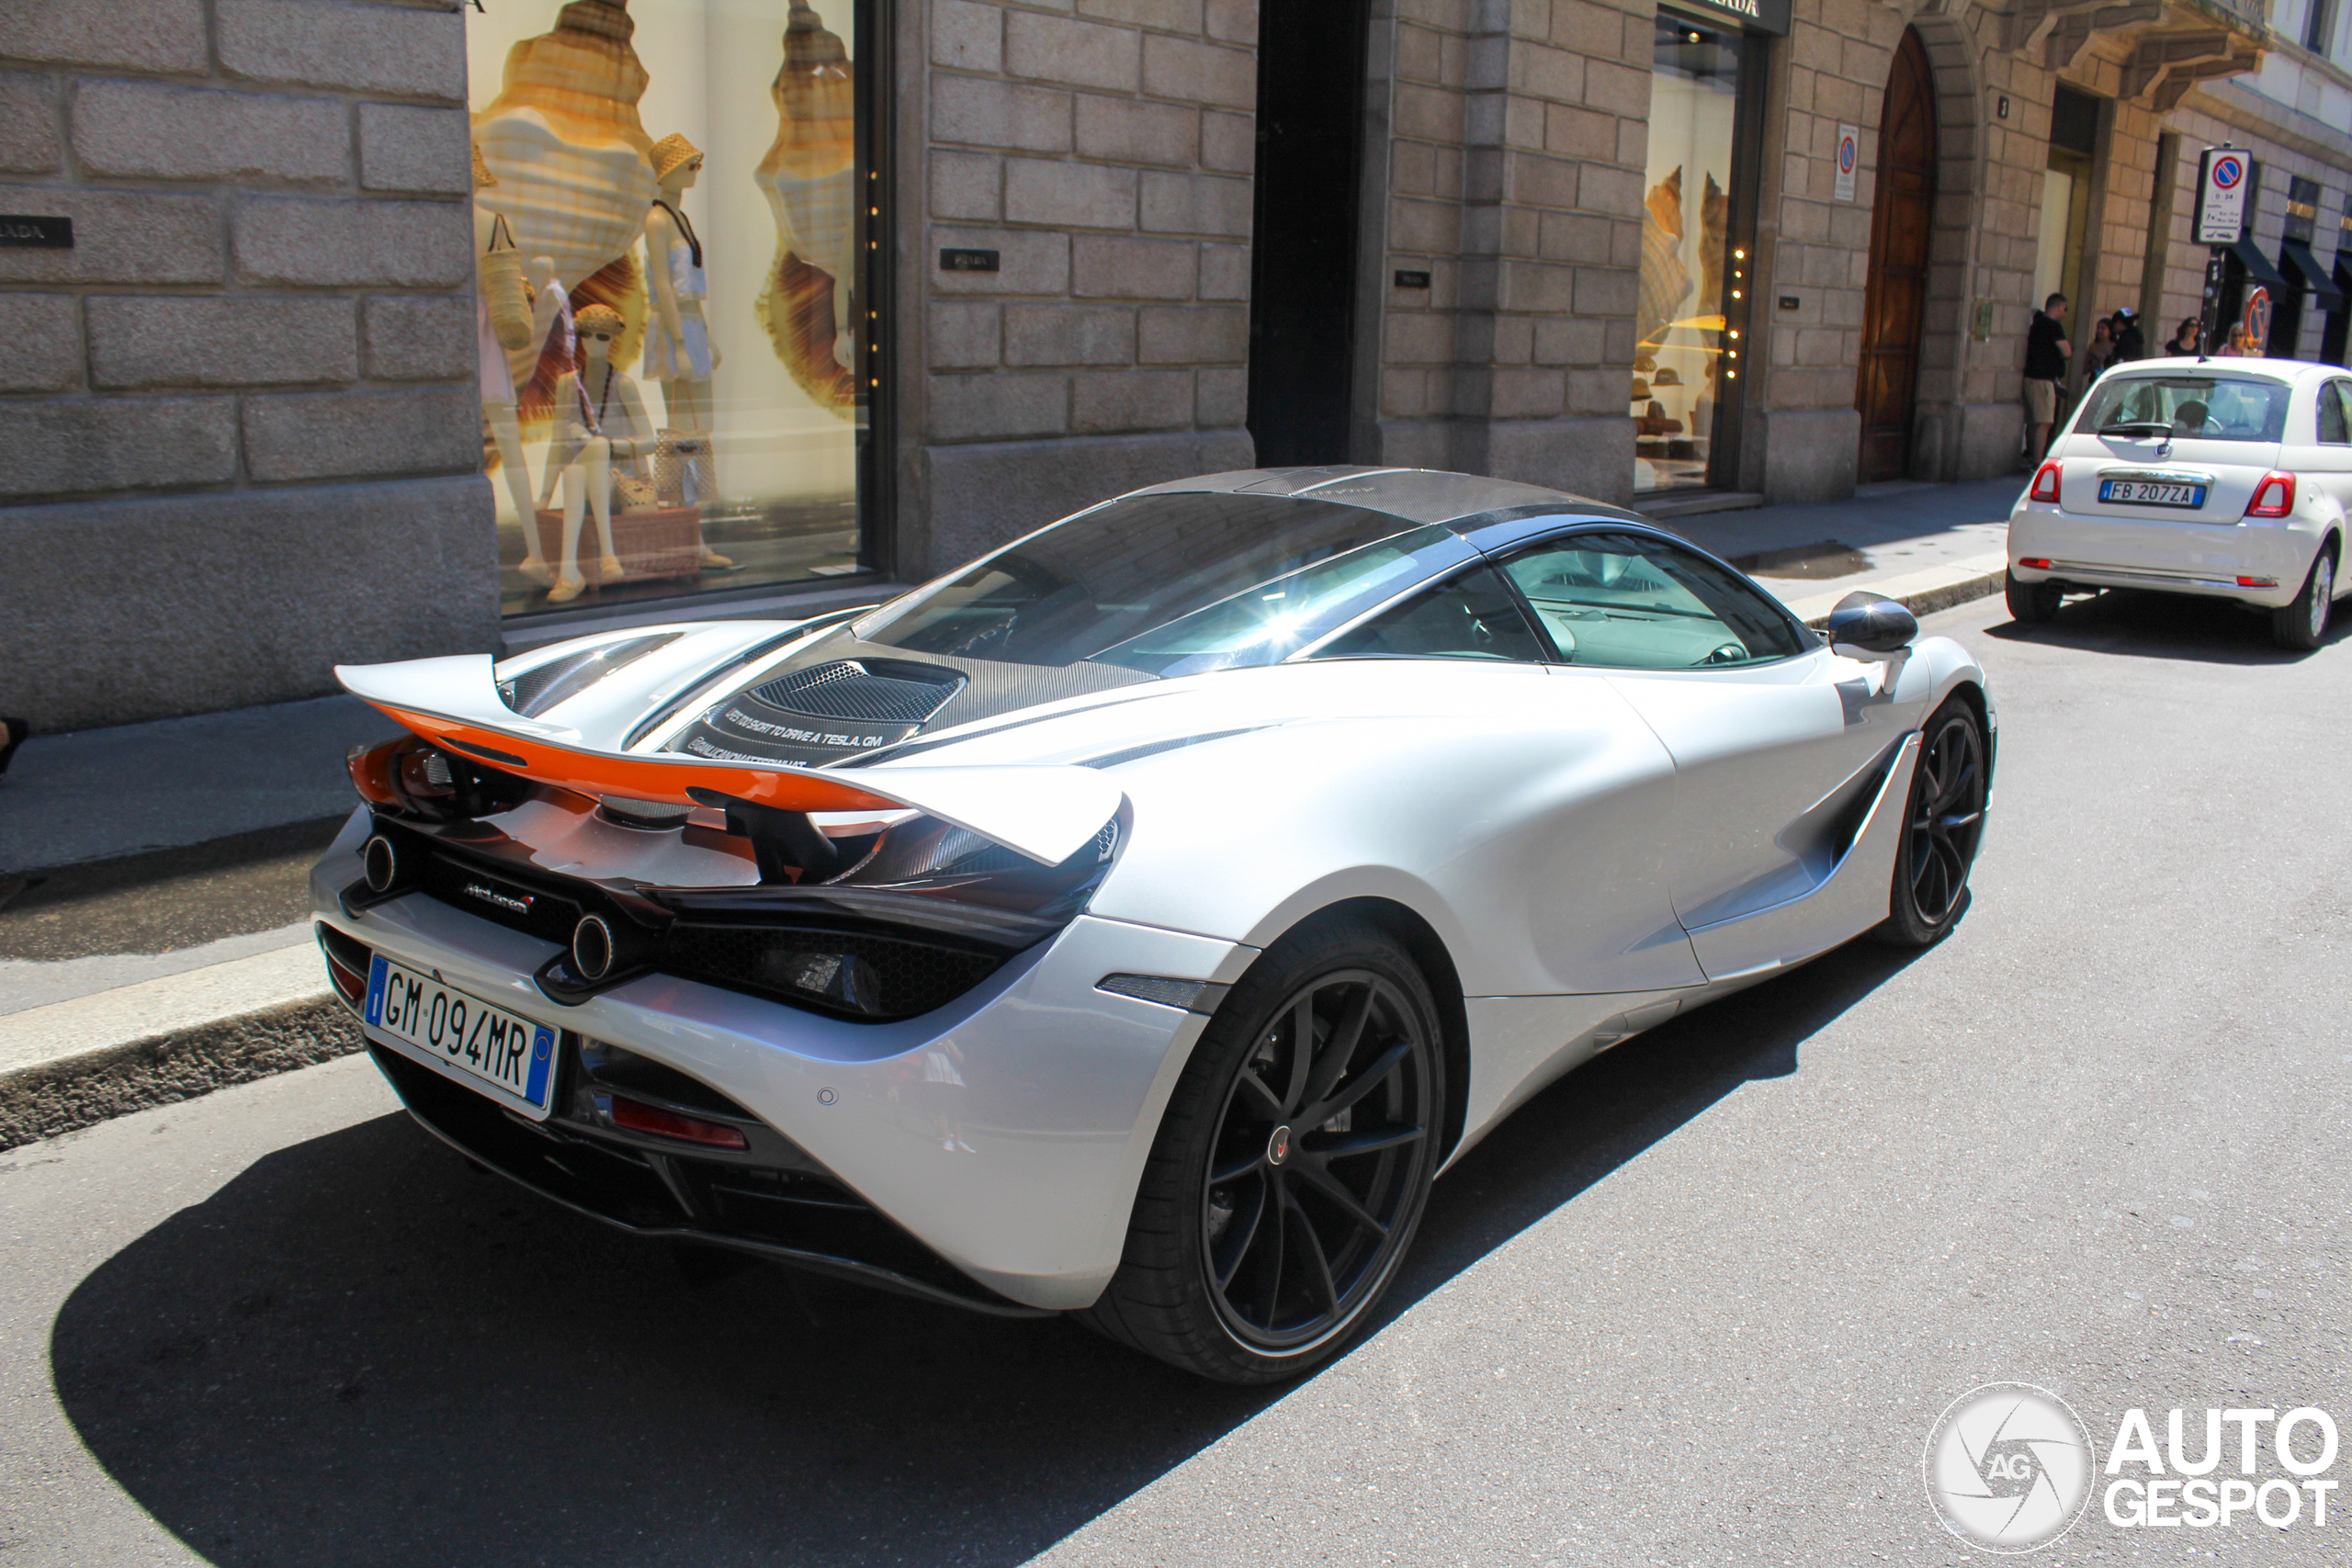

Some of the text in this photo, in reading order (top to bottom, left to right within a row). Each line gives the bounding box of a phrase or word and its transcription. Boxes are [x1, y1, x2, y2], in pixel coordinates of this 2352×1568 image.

[2111, 483, 2132, 499] FB
[2137, 484, 2189, 502] 207ZA
[770, 726, 786, 737] TO
[781, 728, 813, 742] DRIVE
[809, 732, 820, 743] A
[862, 736, 883, 747] GM
[385, 972, 423, 1037] GM
[428, 991, 526, 1087] 094MR
